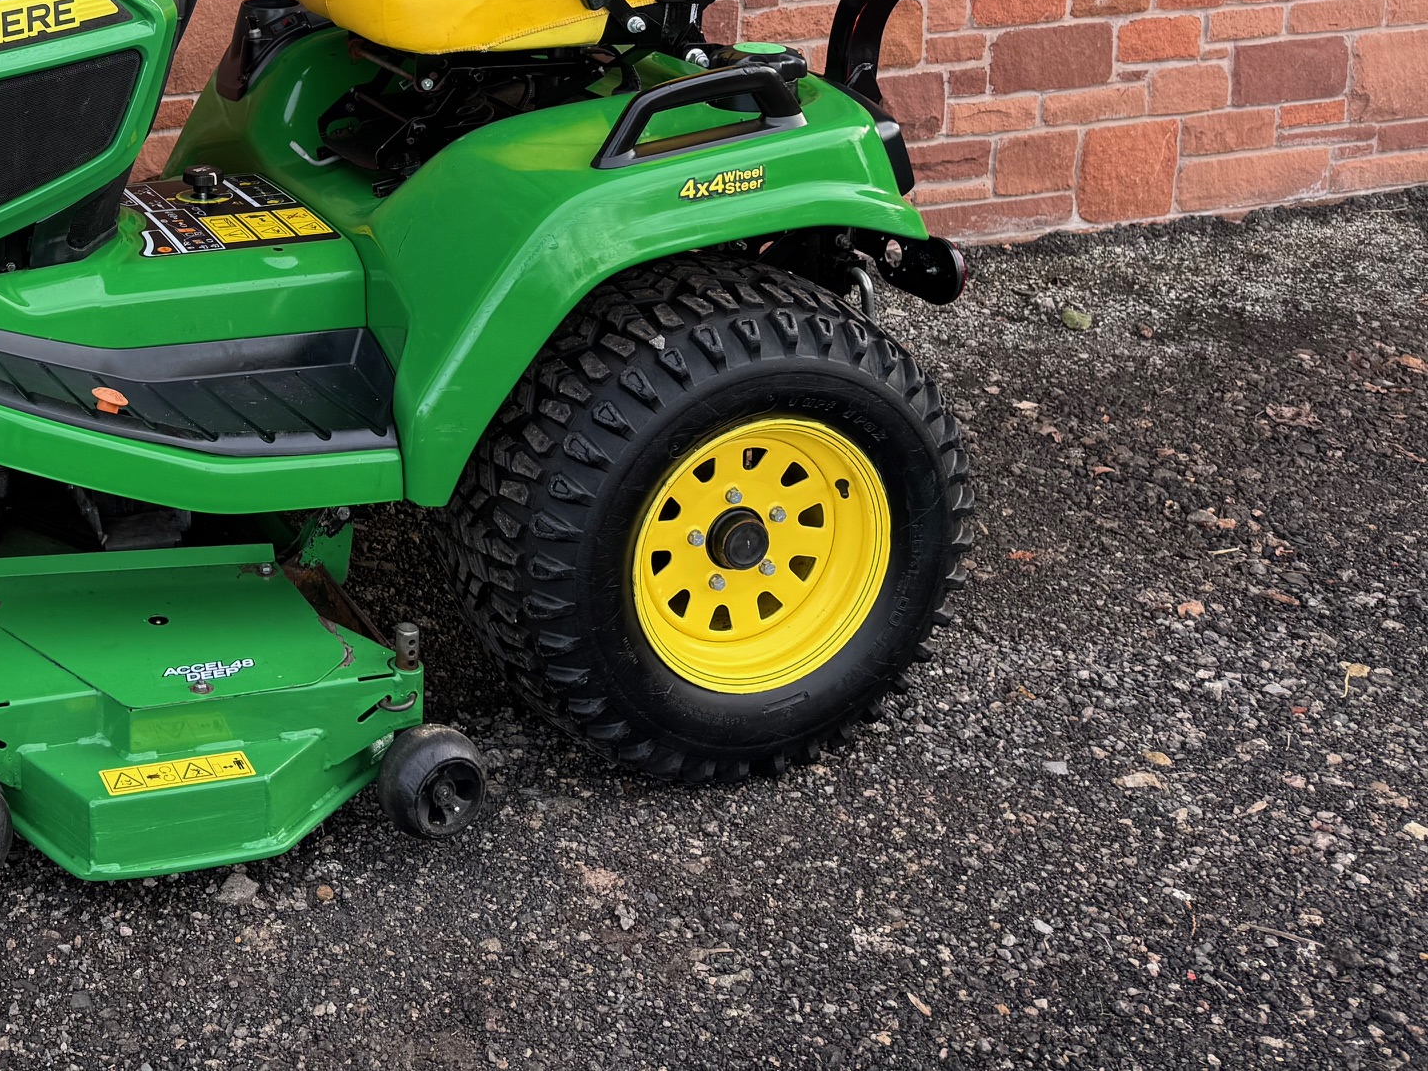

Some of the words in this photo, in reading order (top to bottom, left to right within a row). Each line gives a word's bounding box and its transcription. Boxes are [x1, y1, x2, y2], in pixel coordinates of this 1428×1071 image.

[679, 174, 725, 199] 4x4
[724, 165, 764, 183] Wheel
[725, 178, 764, 195] Steer
[162, 660, 230, 677] ACCEL
[186, 667, 240, 683] DEEP
